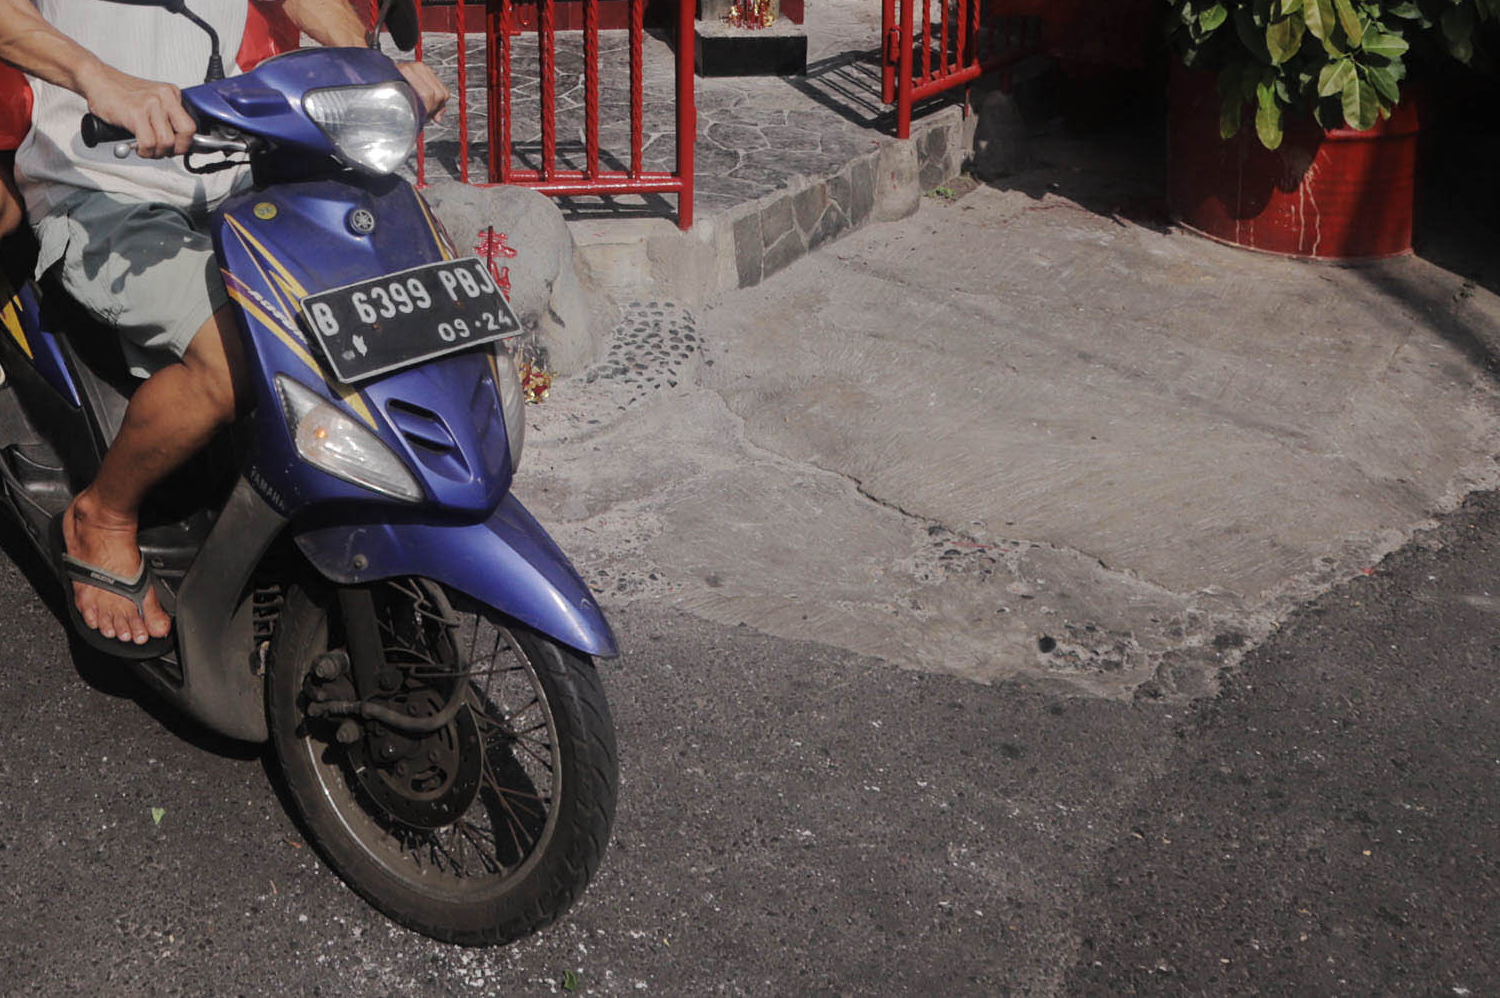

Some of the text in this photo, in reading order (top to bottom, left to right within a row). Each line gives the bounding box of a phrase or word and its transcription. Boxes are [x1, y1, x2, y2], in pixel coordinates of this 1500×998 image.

[311, 302, 339, 337] B
[351, 277, 432, 324] 6399
[437, 263, 496, 302] PBJ
[250, 465, 285, 511] YAMAHA
